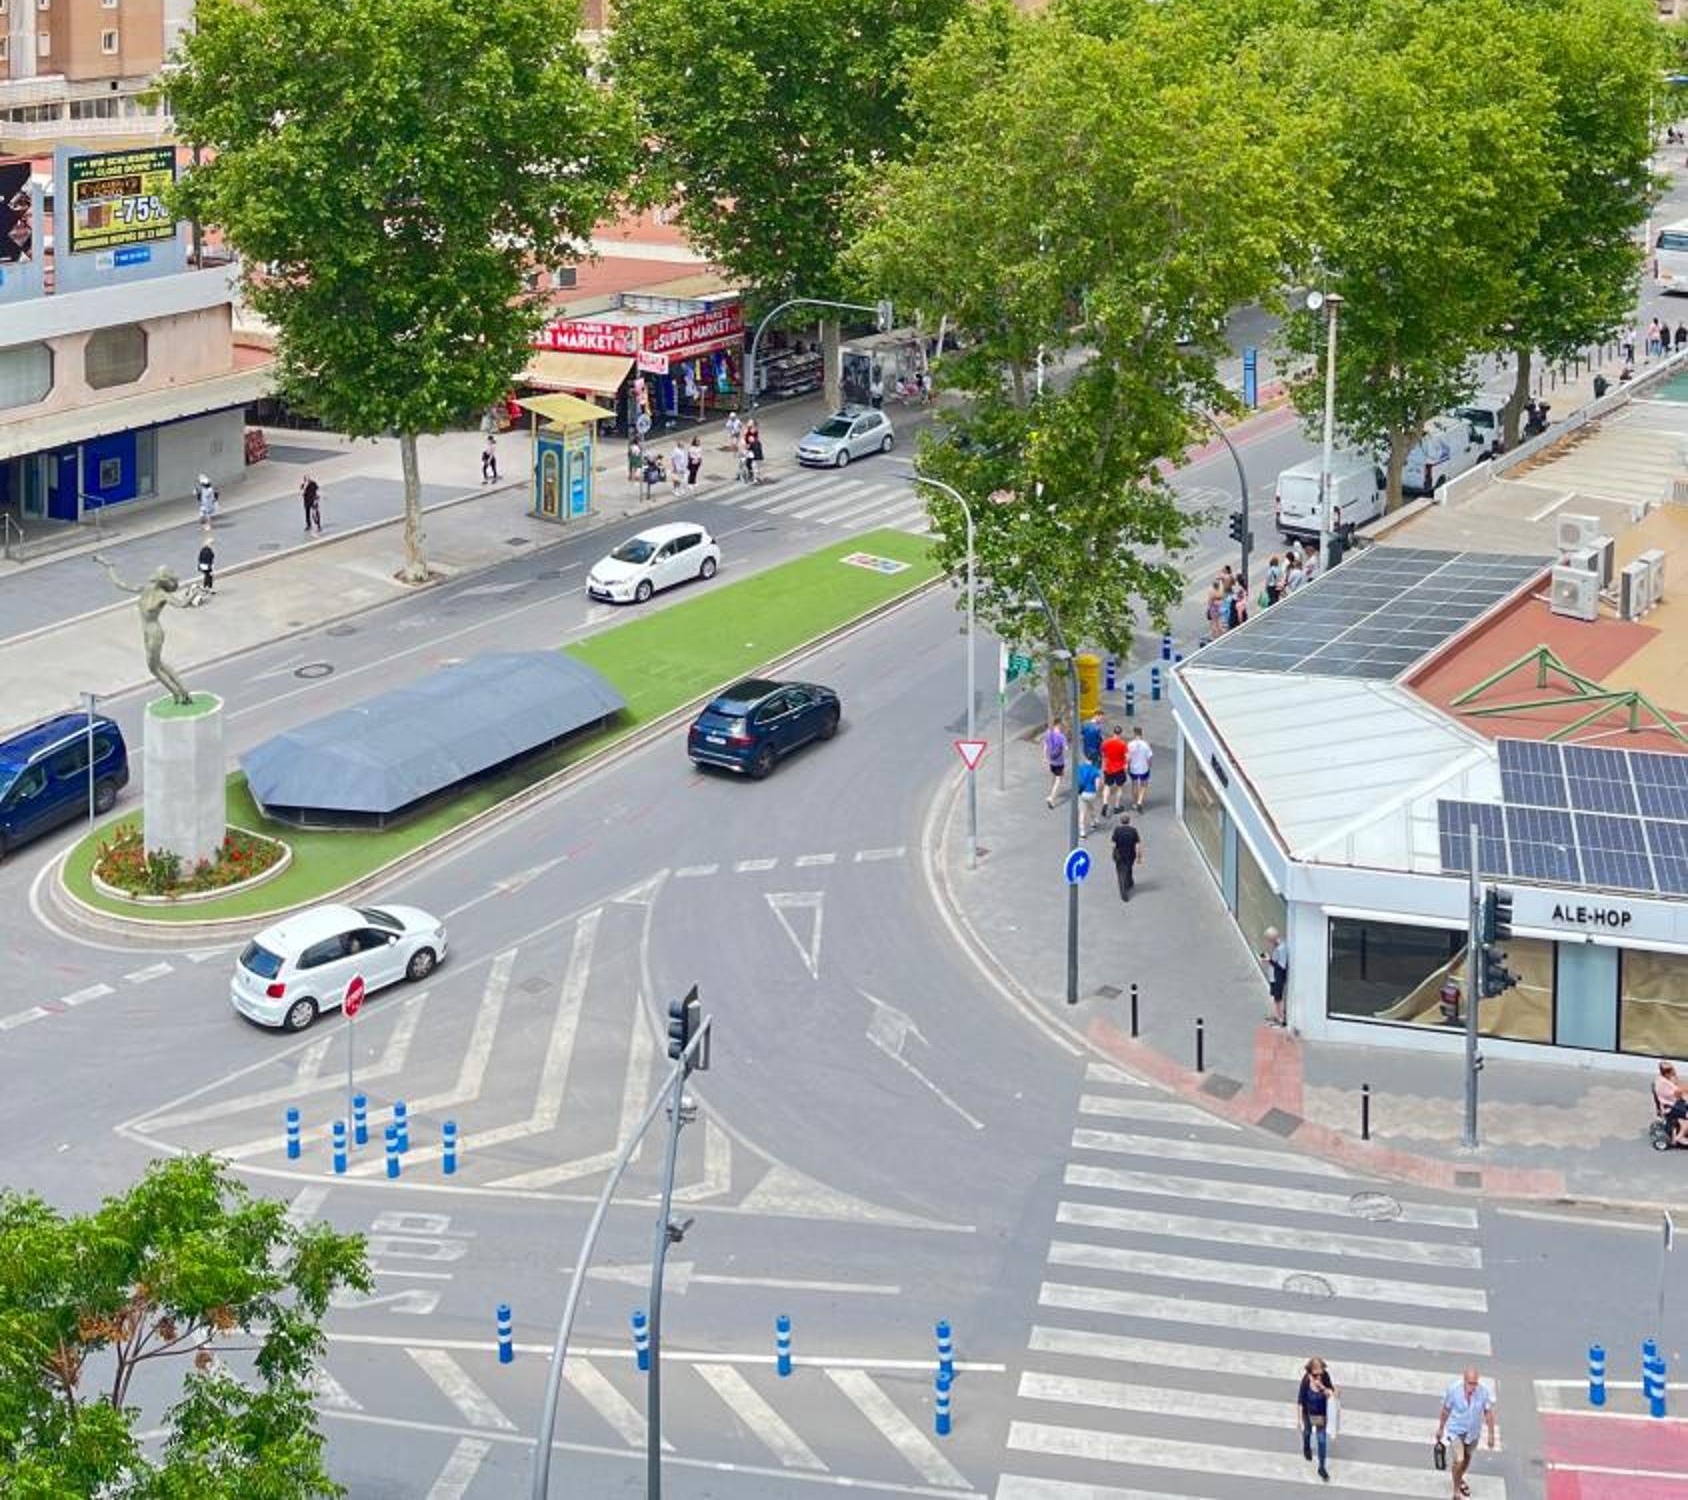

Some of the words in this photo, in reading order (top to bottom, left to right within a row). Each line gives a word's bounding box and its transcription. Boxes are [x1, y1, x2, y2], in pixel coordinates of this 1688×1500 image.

[557, 332, 615, 351] MARKET
[658, 326, 691, 349] SUPER
[691, 318, 731, 342] MARKET
[1552, 904, 1632, 927] ALE-HOP
